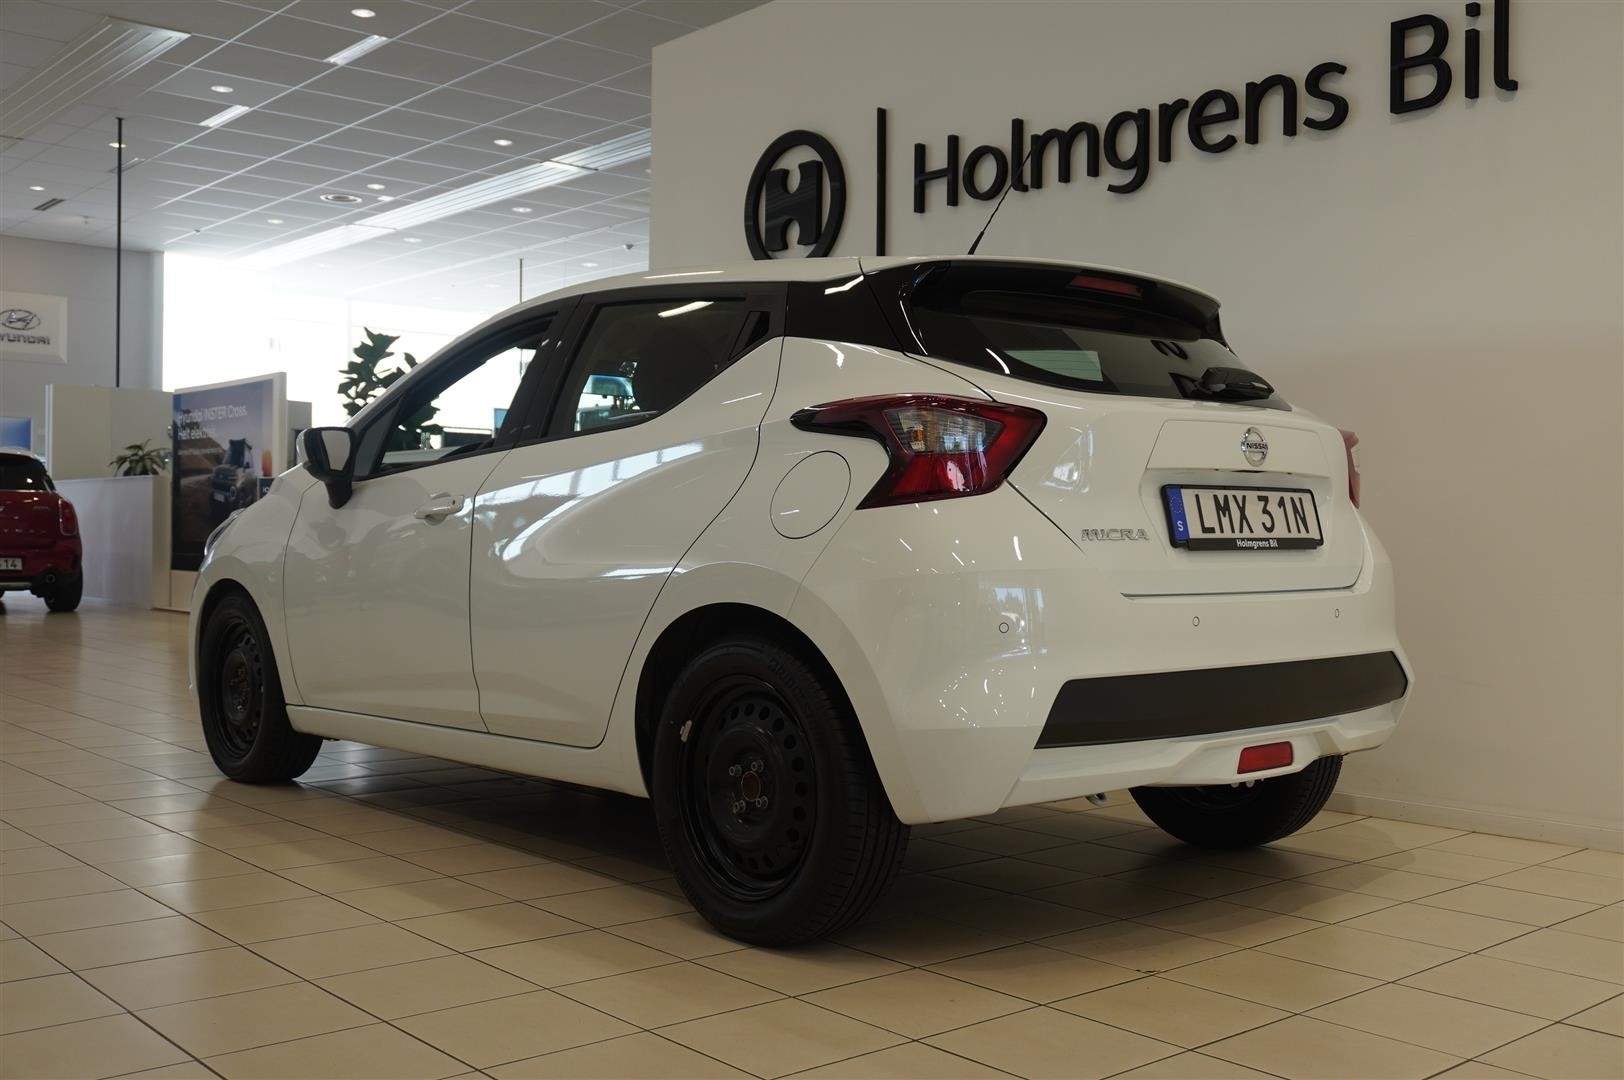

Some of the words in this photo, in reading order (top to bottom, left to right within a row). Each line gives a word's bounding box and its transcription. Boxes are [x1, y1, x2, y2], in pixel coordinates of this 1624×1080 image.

[914, 62, 1349, 214] Holmgrens
[1389, 0, 1519, 115] Bil
[1246, 442, 1268, 450] NISSAN
[1195, 493, 1254, 534] LMX
[1257, 495, 1310, 534] 31N
[1177, 520, 1184, 532] S
[1081, 528, 1150, 541] MICRA
[1236, 538, 1269, 549] Holmgrens
[1270, 538, 1279, 548] Bil
[0, 559, 17, 569] 14
